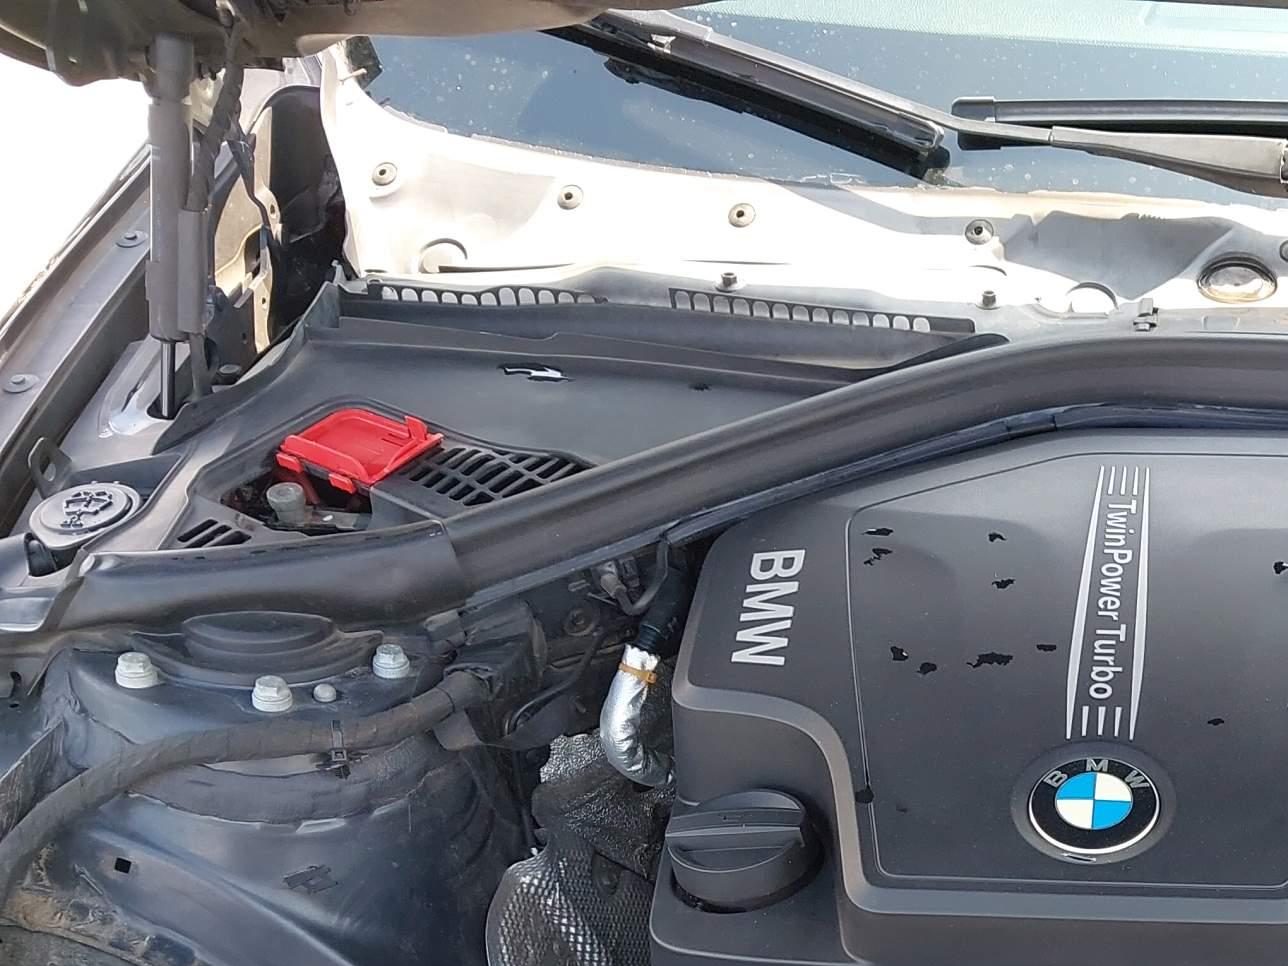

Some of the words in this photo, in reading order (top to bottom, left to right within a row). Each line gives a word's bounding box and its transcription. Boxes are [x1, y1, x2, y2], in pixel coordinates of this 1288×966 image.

[730, 549, 806, 666] BMW
[1097, 499, 1137, 621] TwinPower
[1088, 623, 1127, 700] Turbo
[1042, 758, 1150, 789] BMW
